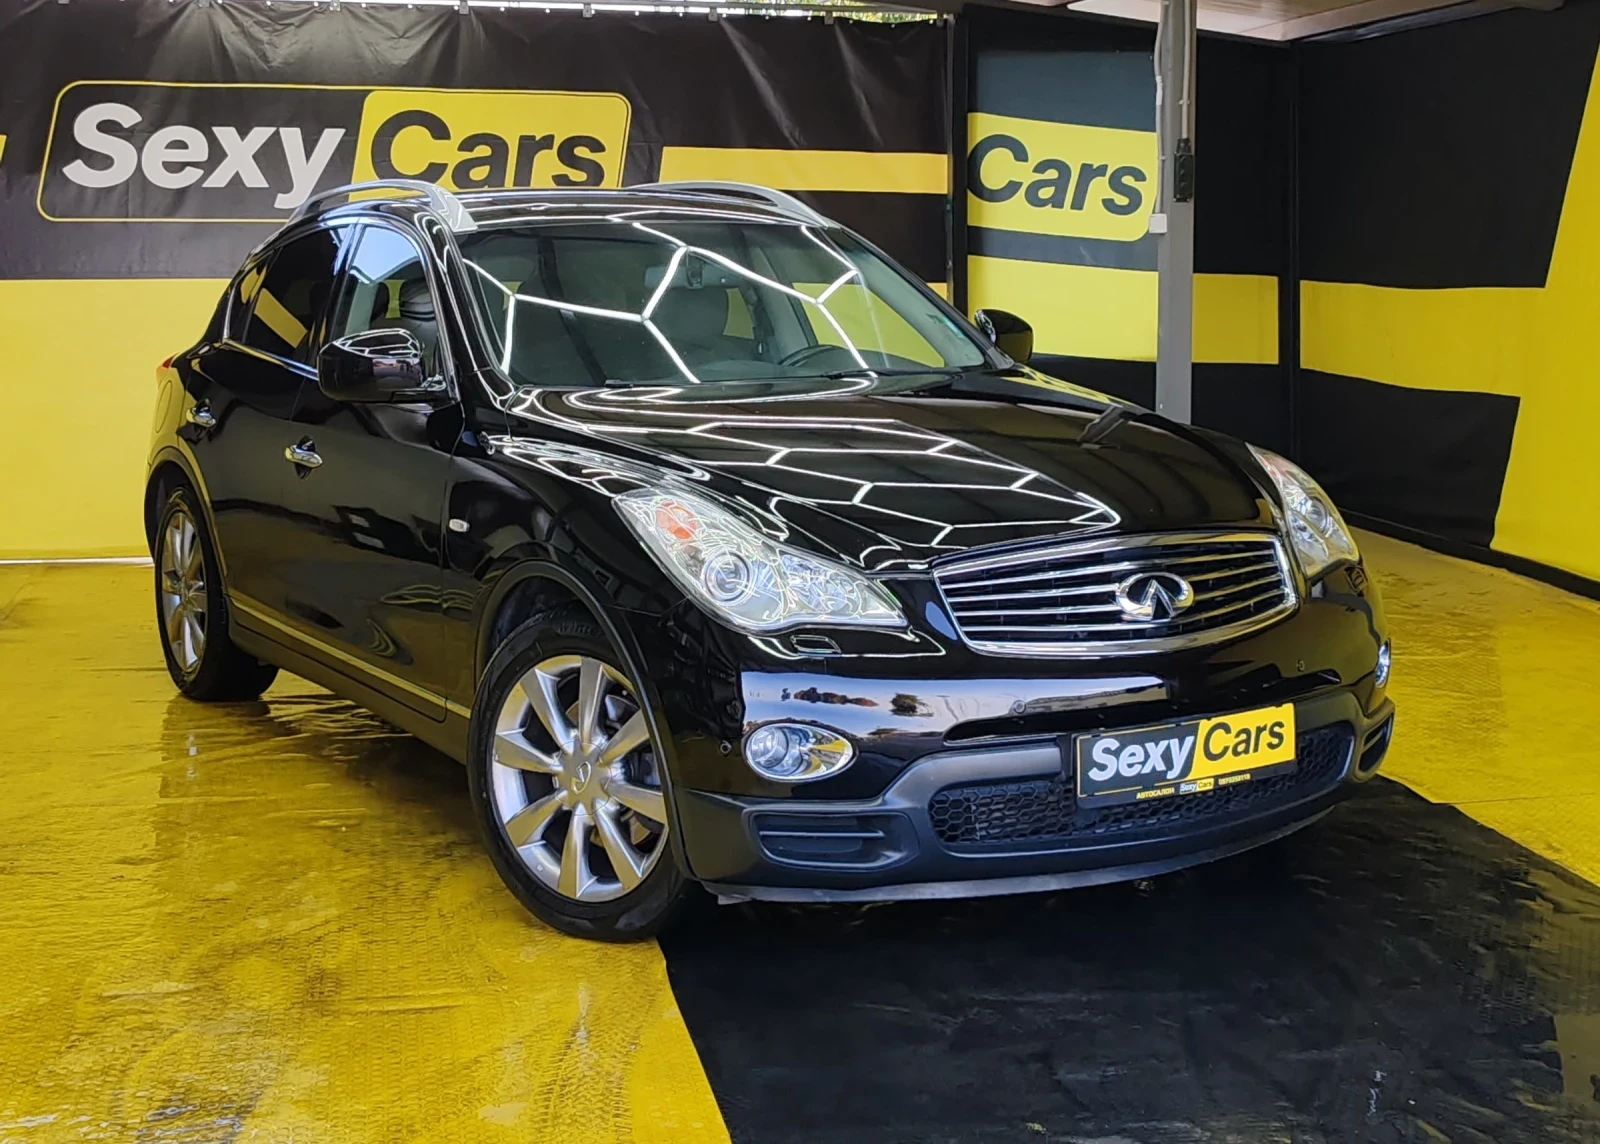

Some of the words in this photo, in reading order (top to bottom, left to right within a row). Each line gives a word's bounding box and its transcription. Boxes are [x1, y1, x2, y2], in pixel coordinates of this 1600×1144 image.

[62, 102, 346, 209] Sexy
[371, 110, 606, 190] Cars
[967, 134, 1147, 215] Cars
[1088, 736, 1195, 781] Sexy
[1203, 721, 1285, 762] Cars
[1180, 781, 1197, 793] Sexy
[1198, 779, 1212, 789] Cars
